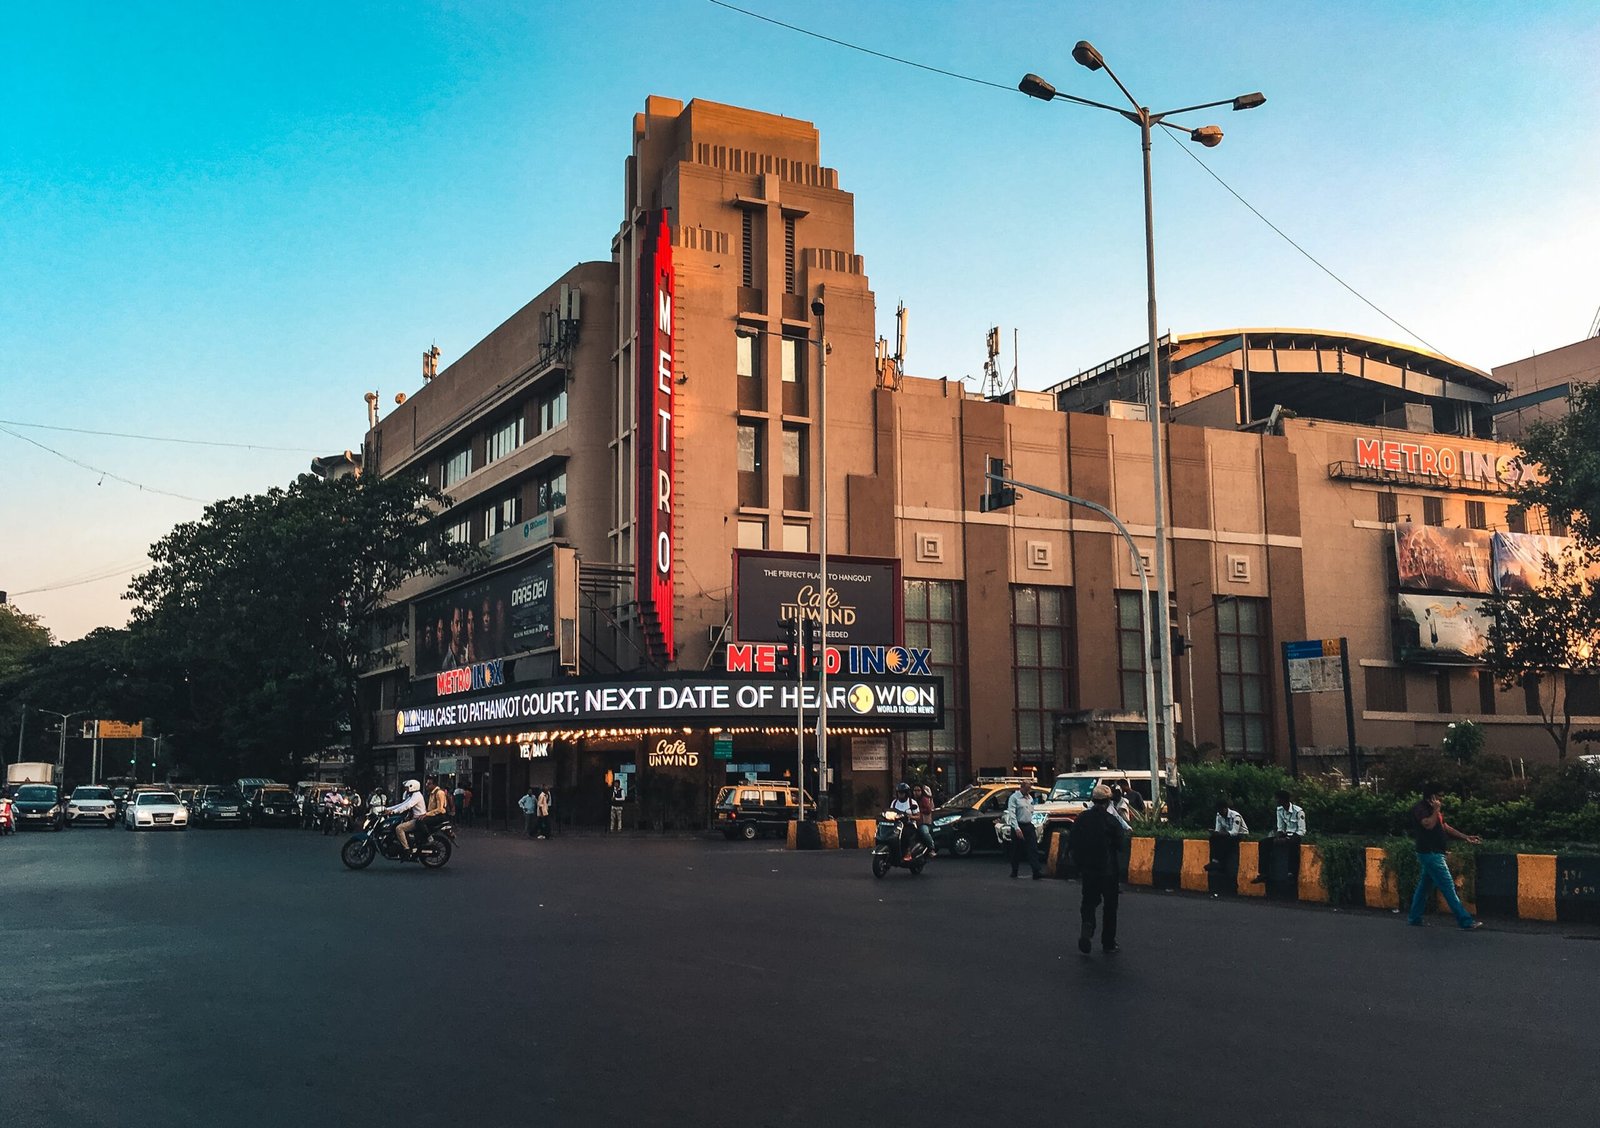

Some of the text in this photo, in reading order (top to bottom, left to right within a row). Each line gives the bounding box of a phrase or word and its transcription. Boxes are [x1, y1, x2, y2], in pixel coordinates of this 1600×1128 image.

[657, 290, 672, 574] METRO
[1356, 438, 1457, 478] METRO
[764, 569, 872, 583] THE PERFECT PLAC TO HANGOUT
[532, 579, 549, 600] DEV
[797, 585, 840, 608] Café
[727, 644, 932, 676] MEO INOX
[436, 660, 504, 697] METRO INOX
[875, 685, 935, 706] WION
[420, 707, 436, 729] HUA
[436, 705, 457, 727] CASE
[457, 703, 469, 723] TO
[469, 696, 520, 722] PATHANKOT
[522, 690, 579, 716] COURT;
[585, 687, 652, 711] NEXT
[658, 686, 730, 709] DATE
[736, 685, 775, 709] OF
[876, 704, 935, 715] WORLD IS ONE NEWS
[519, 742, 549, 758] YES BANK
[656, 739, 687, 755] Café
[649, 754, 699, 767] UNWIND
